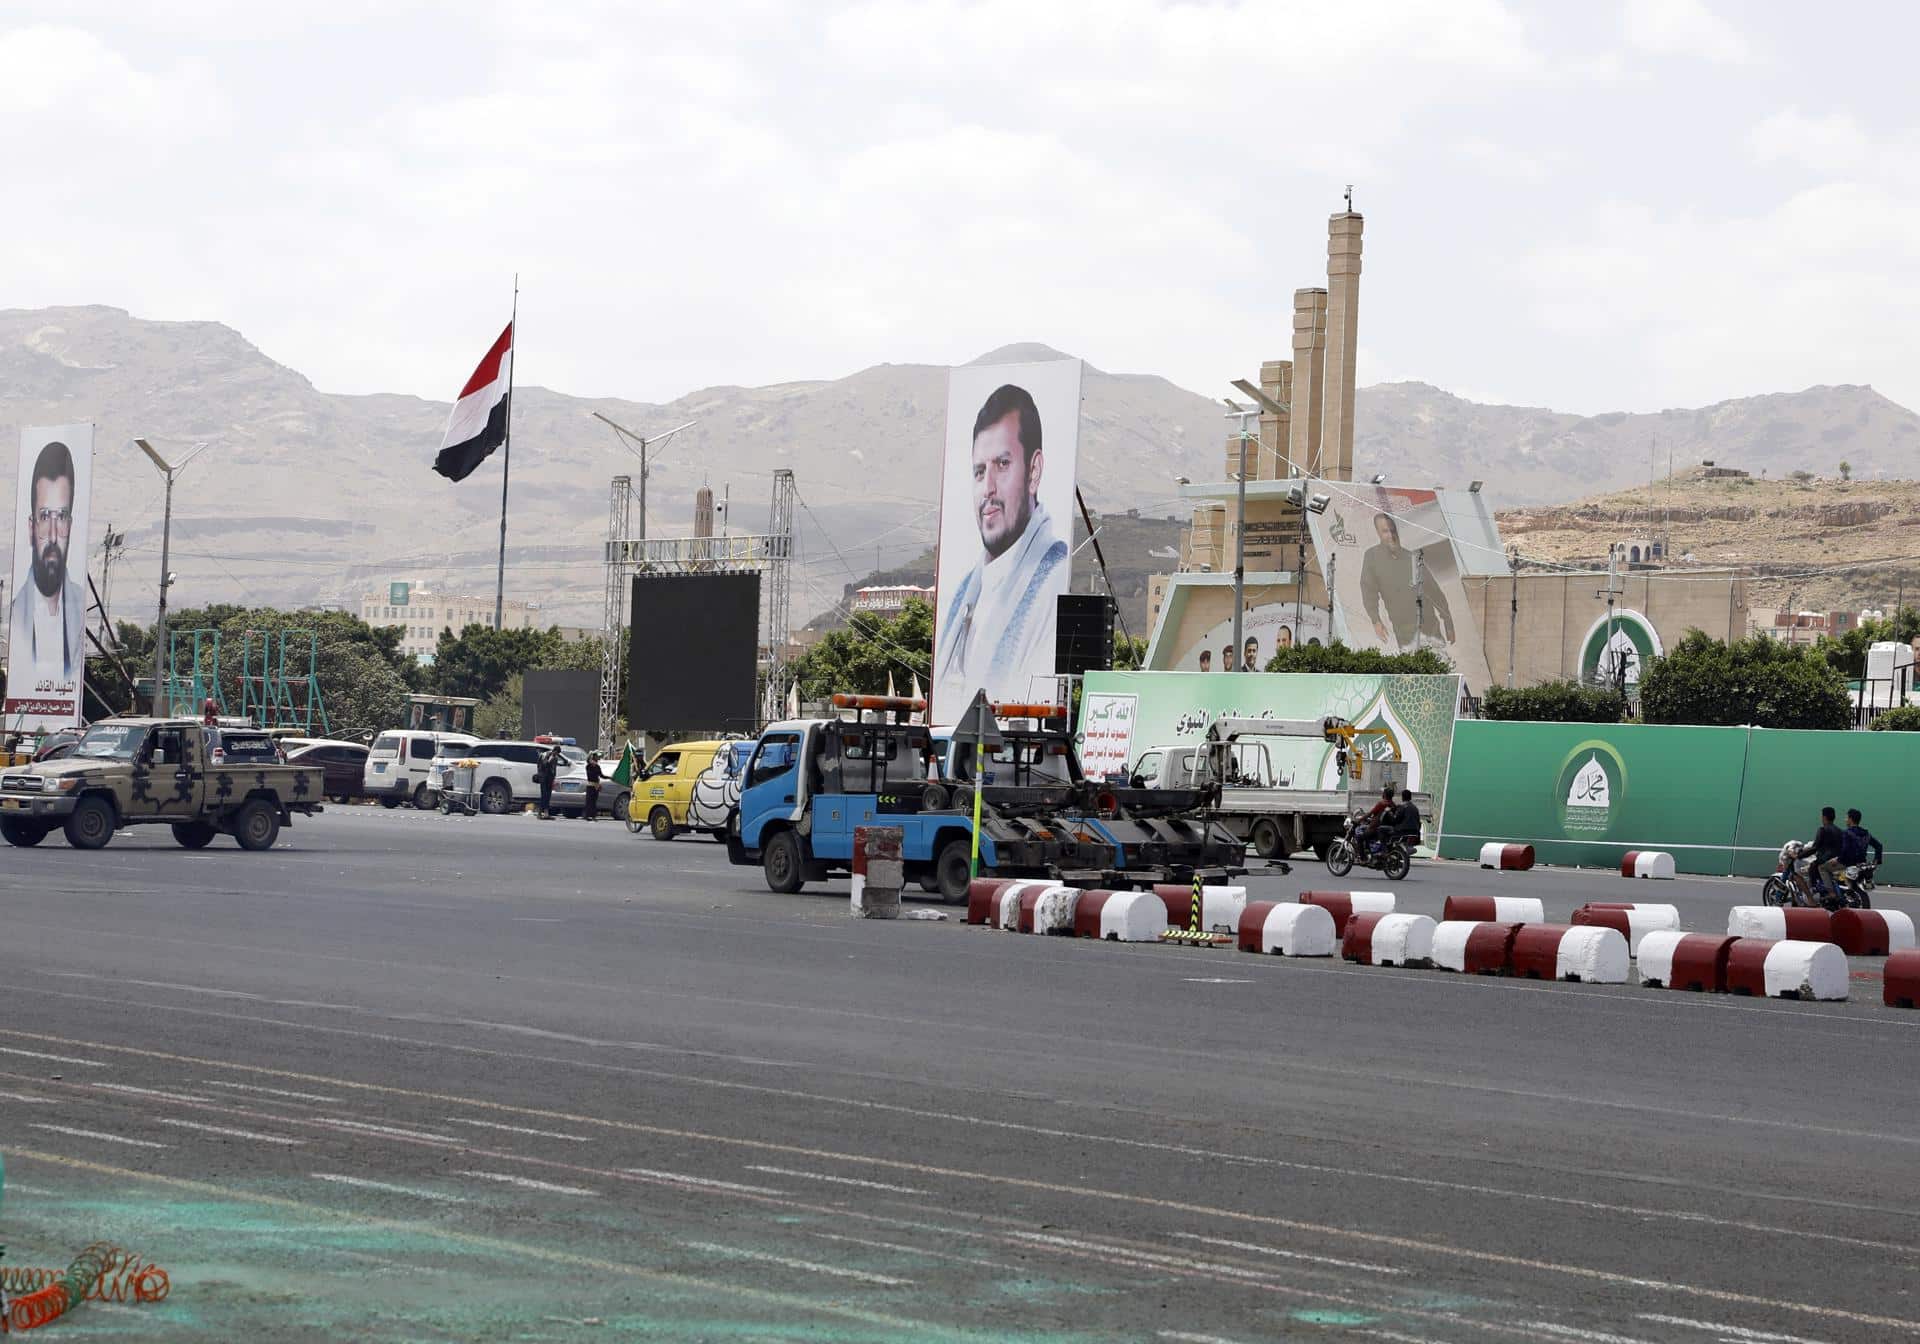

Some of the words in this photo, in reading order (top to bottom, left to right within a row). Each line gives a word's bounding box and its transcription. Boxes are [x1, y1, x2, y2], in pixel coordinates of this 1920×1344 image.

[35, 679, 54, 692] القائد
[55, 680, 76, 696] الشهيد
[1176, 709, 1210, 736] النبوي
